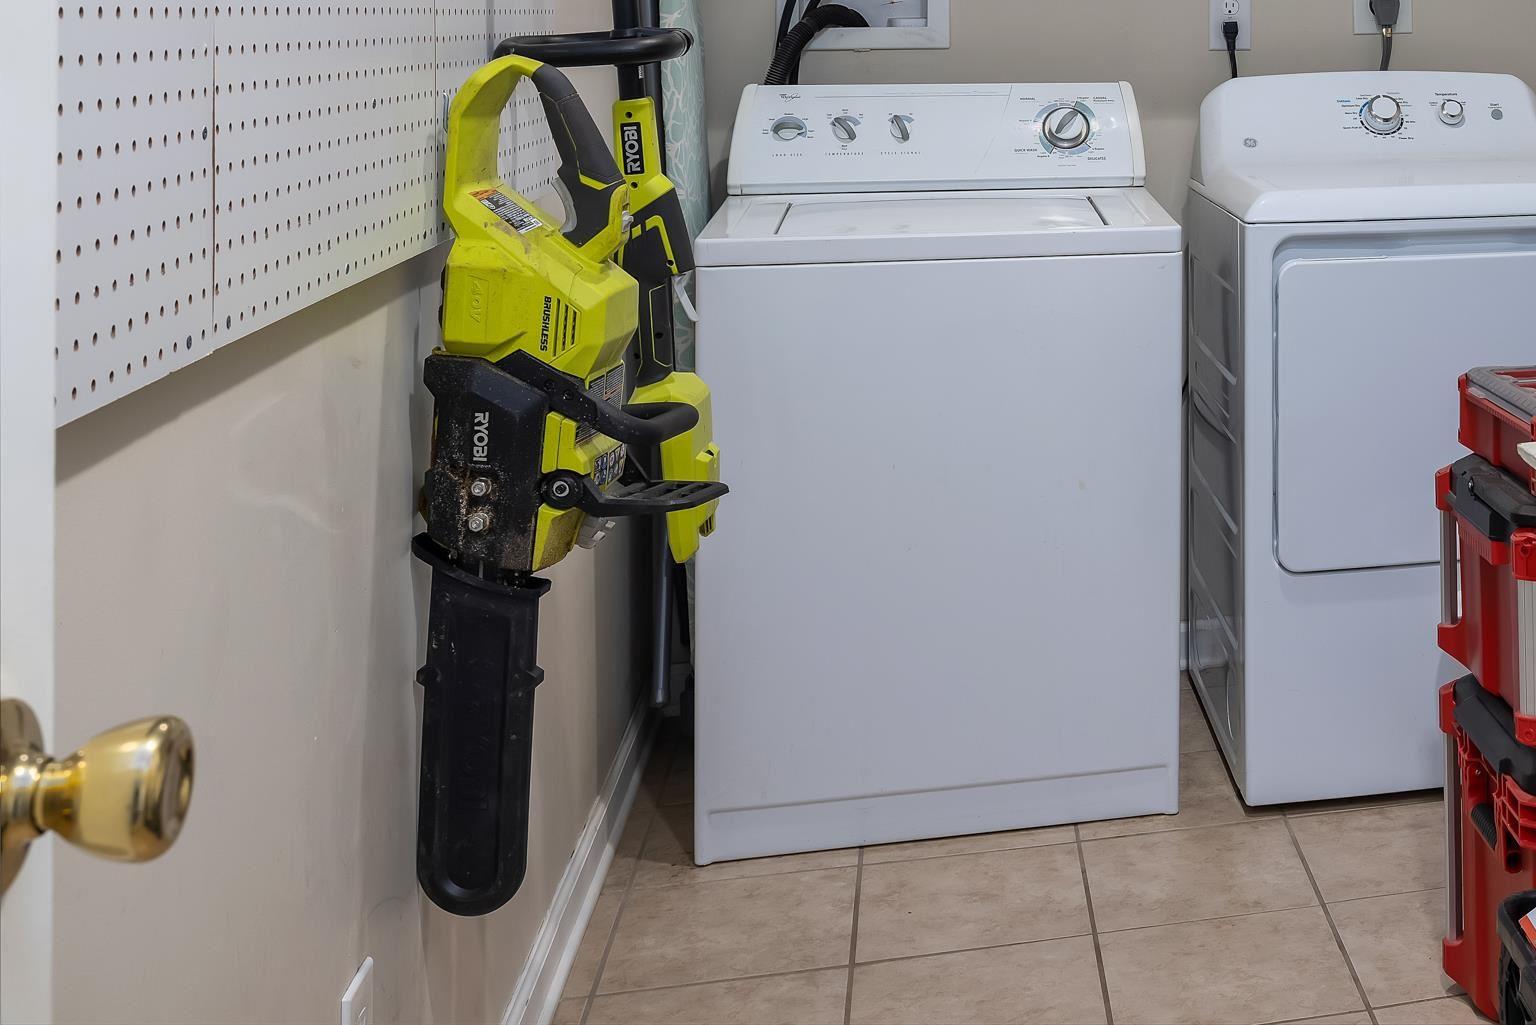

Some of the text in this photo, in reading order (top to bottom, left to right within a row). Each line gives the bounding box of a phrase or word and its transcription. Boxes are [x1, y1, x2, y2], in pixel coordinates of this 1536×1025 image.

[623, 125, 641, 173] RYOBI
[539, 295, 552, 352] BRUSHLESS
[472, 411, 490, 462] RYOBI
